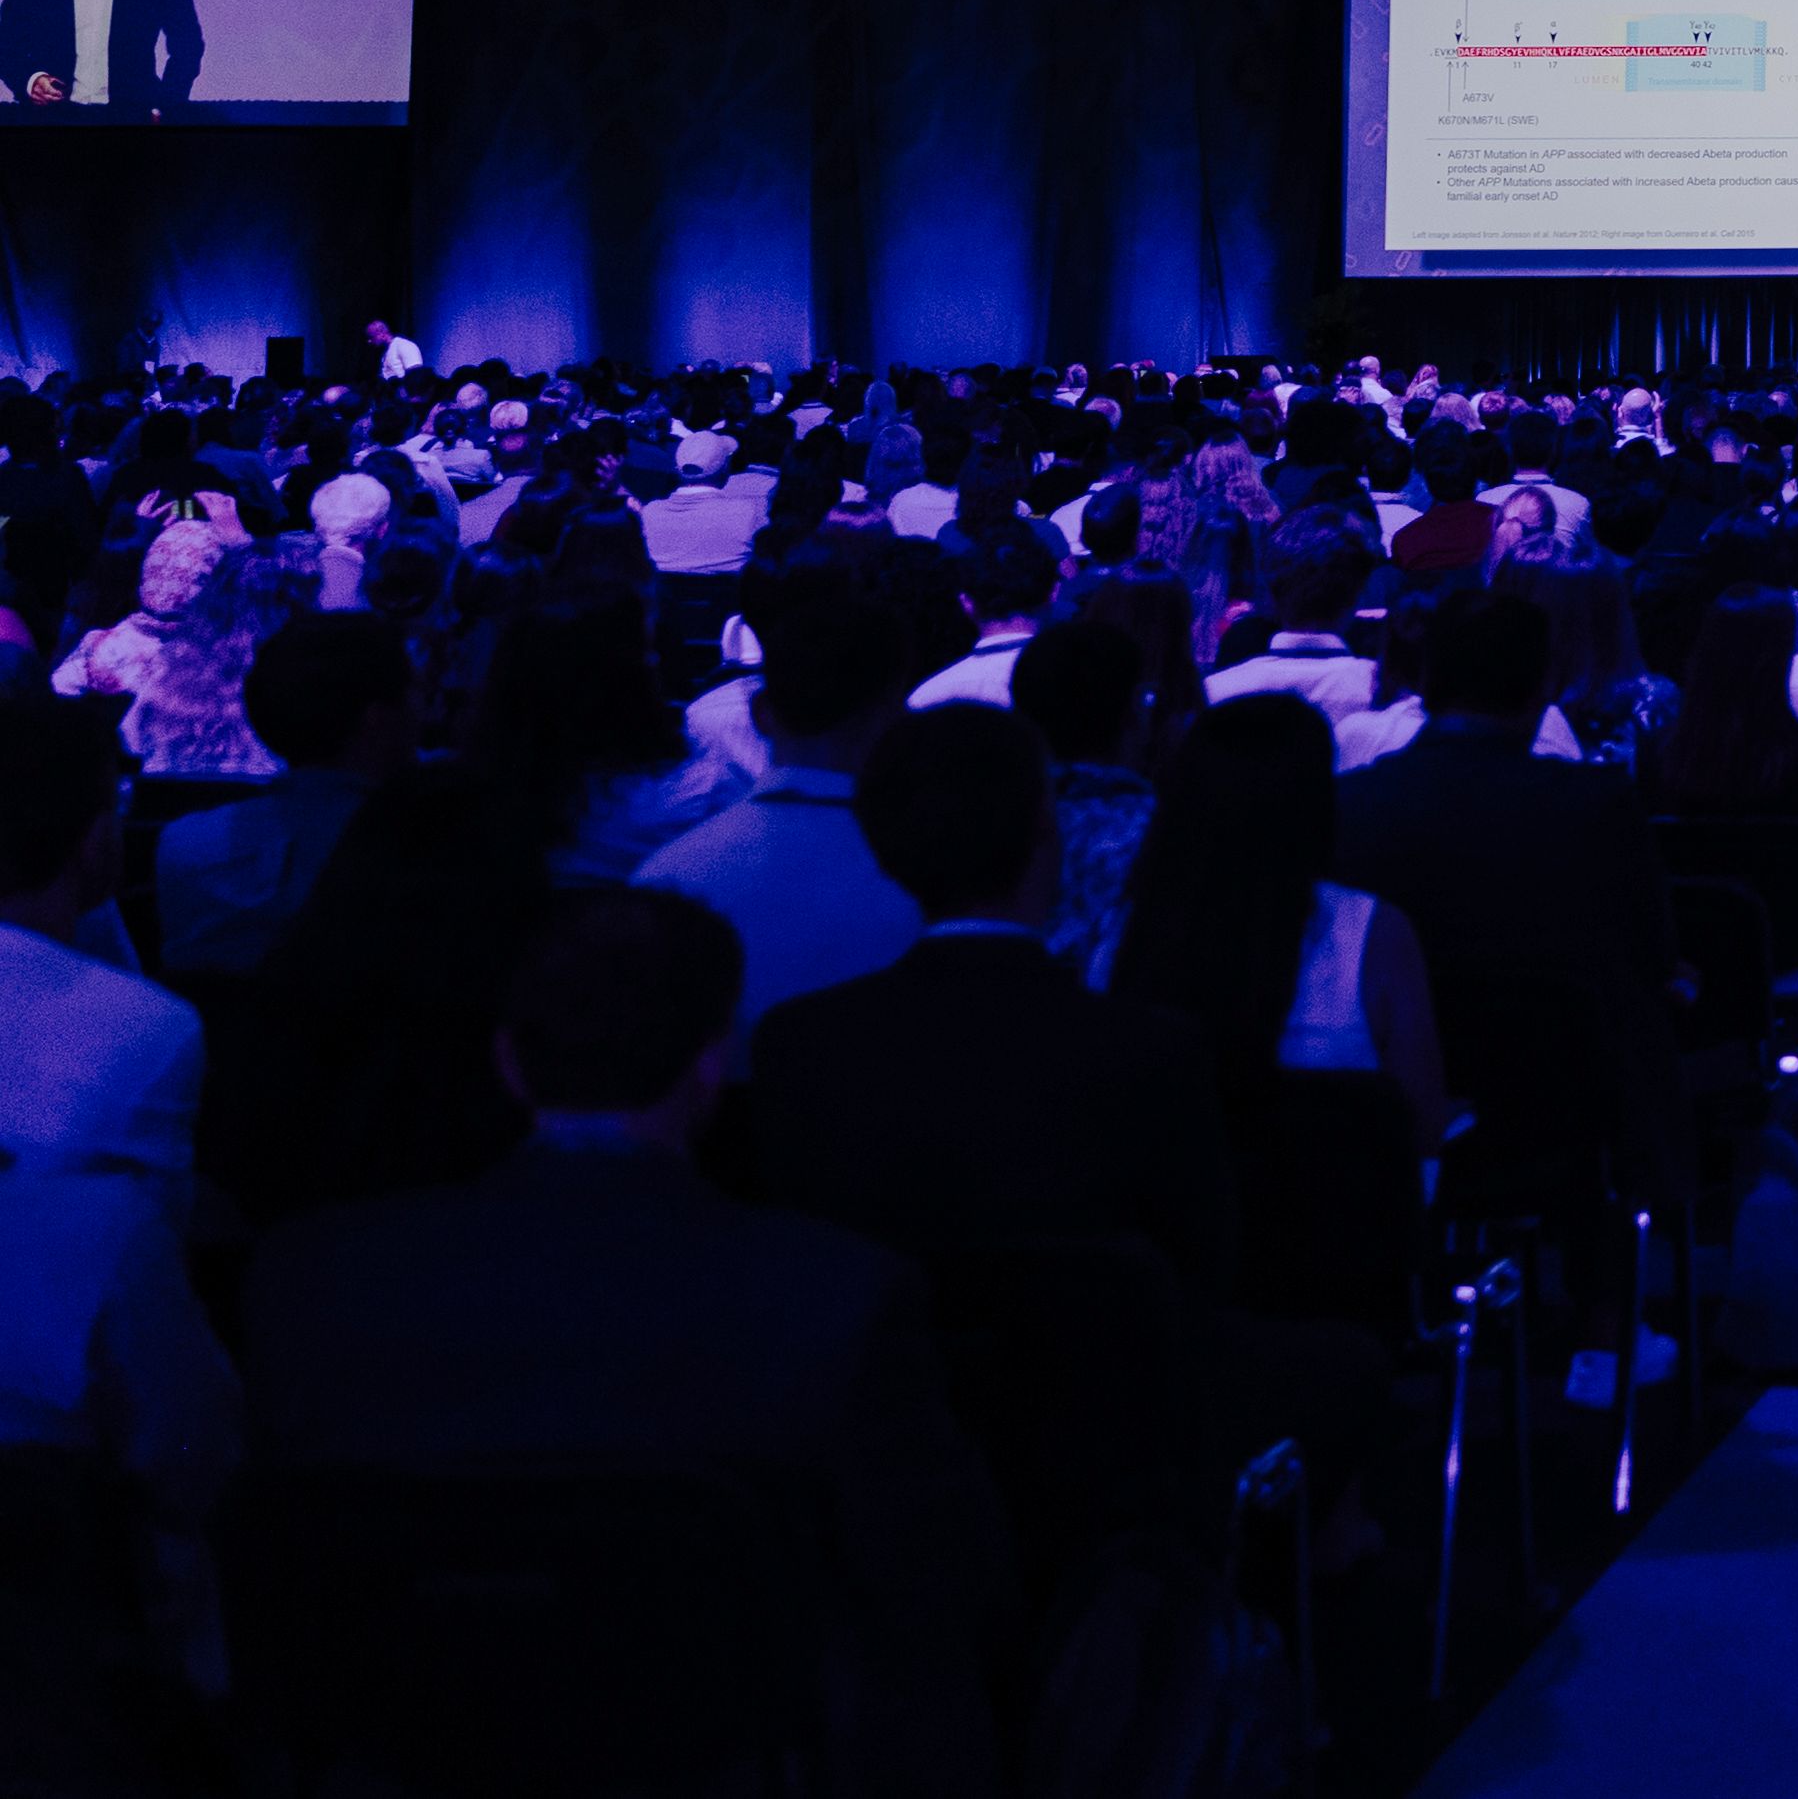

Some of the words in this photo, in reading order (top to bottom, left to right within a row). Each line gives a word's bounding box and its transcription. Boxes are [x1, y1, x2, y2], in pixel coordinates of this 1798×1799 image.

[1447, 149, 1481, 160] A673T
[1483, 149, 1527, 159] Mutation
[1530, 150, 1539, 159] in
[1541, 149, 1566, 159] APP
[1567, 149, 1622, 159] associated
[1624, 149, 1645, 159] with
[1647, 149, 1701, 159] decreased
[1702, 149, 1732, 159] Abeta
[1735, 149, 1788, 161] production
[1447, 164, 1488, 176] protects
[1490, 164, 1527, 176] against
[1529, 163, 1546, 173] AD
[1447, 177, 1476, 187] Other
[1477, 177, 1502, 187] APP
[1503, 177, 1552, 187] Mutations
[1555, 177, 1609, 187] associated
[1612, 177, 1633, 186] with
[1635, 177, 1684, 186] increased
[1686, 176, 1716, 186] Abeta
[1719, 176, 1772, 188] production
[1447, 191, 1482, 201] familial
[1484, 192, 1510, 203] early
[1511, 192, 1540, 201] onset
[1541, 191, 1559, 201] AD
